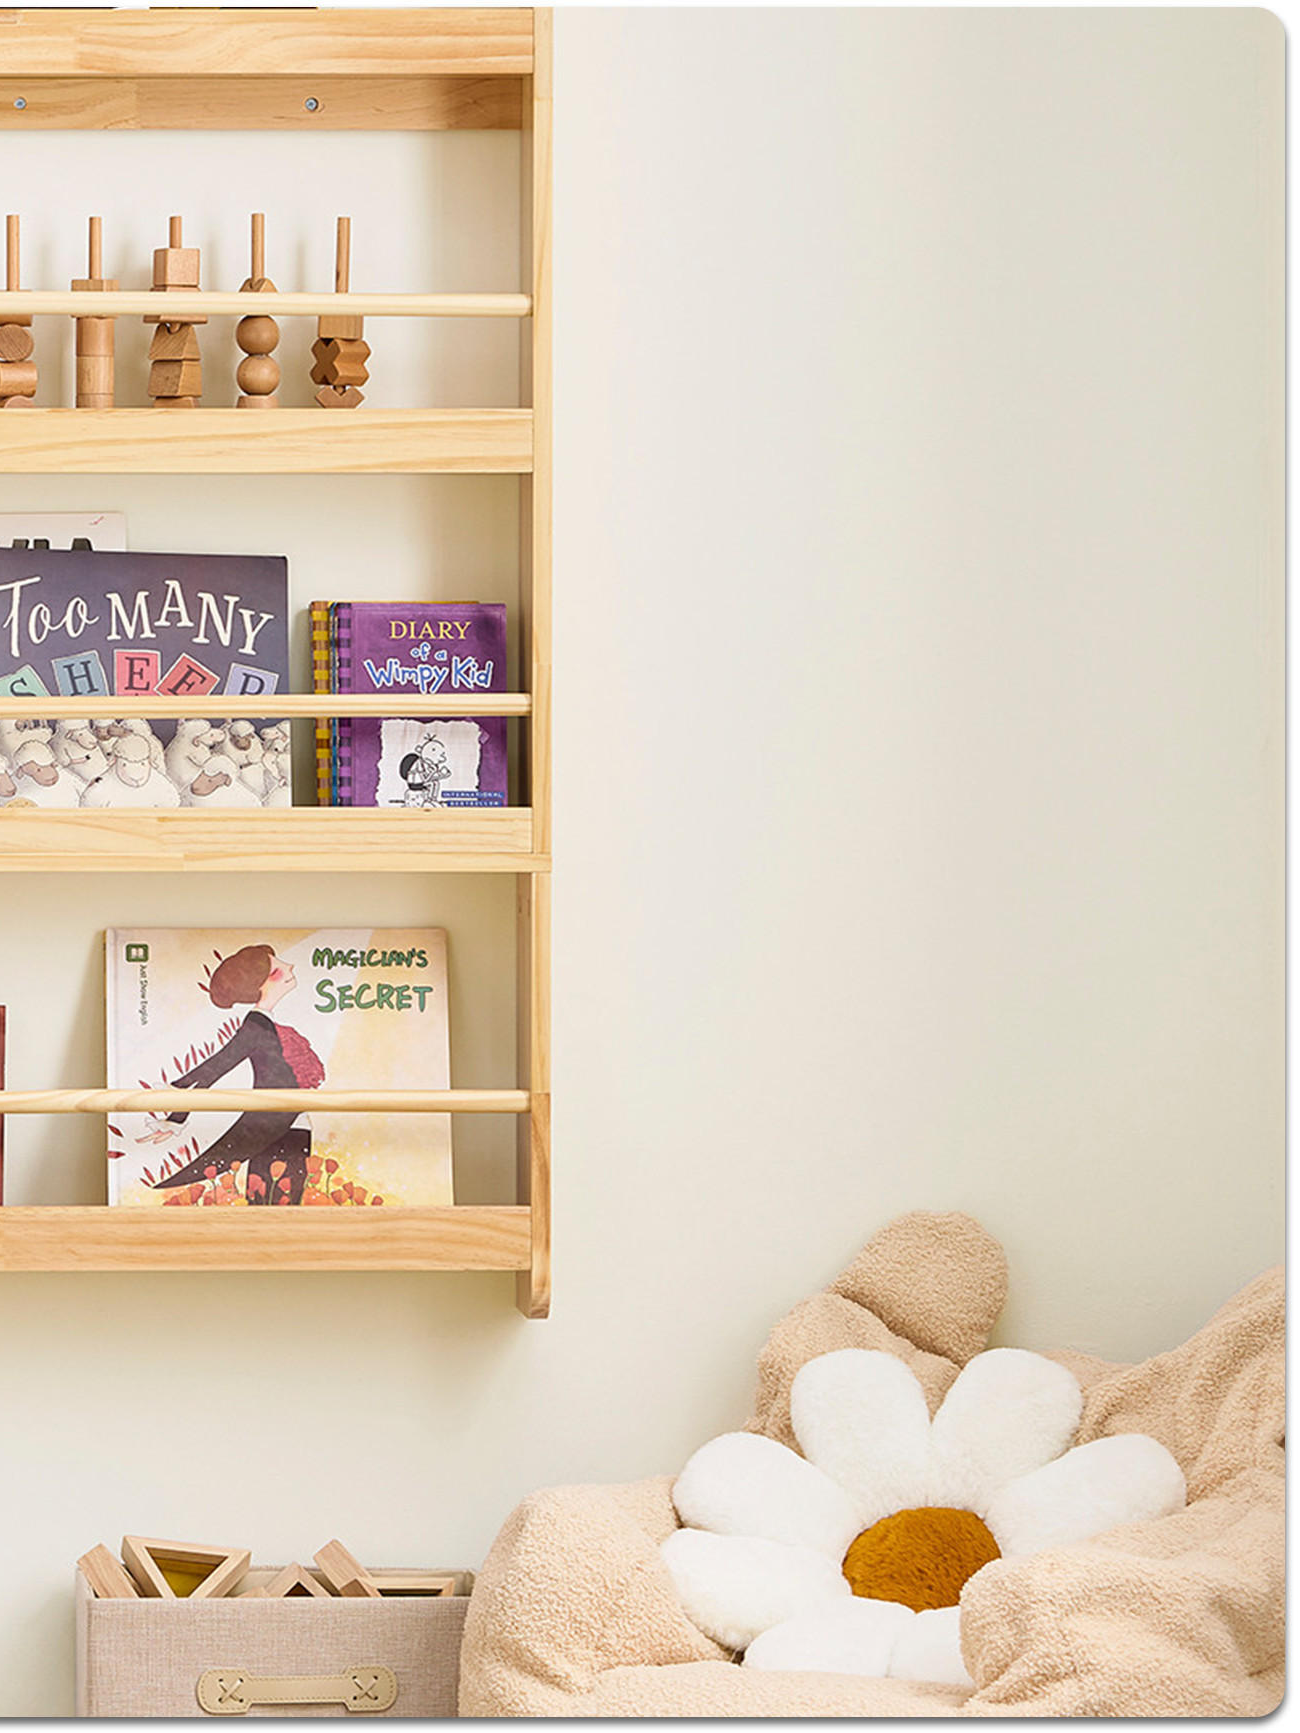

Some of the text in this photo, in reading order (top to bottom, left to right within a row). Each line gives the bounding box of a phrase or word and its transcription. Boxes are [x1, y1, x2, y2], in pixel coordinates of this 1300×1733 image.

[105, 579, 275, 656] MANY
[389, 620, 472, 640] DIARY
[410, 641, 448, 661] of a
[363, 656, 494, 694] Wimpy Kid
[311, 947, 429, 970] MAGICIAN'S
[314, 978, 434, 1013] SECRET
